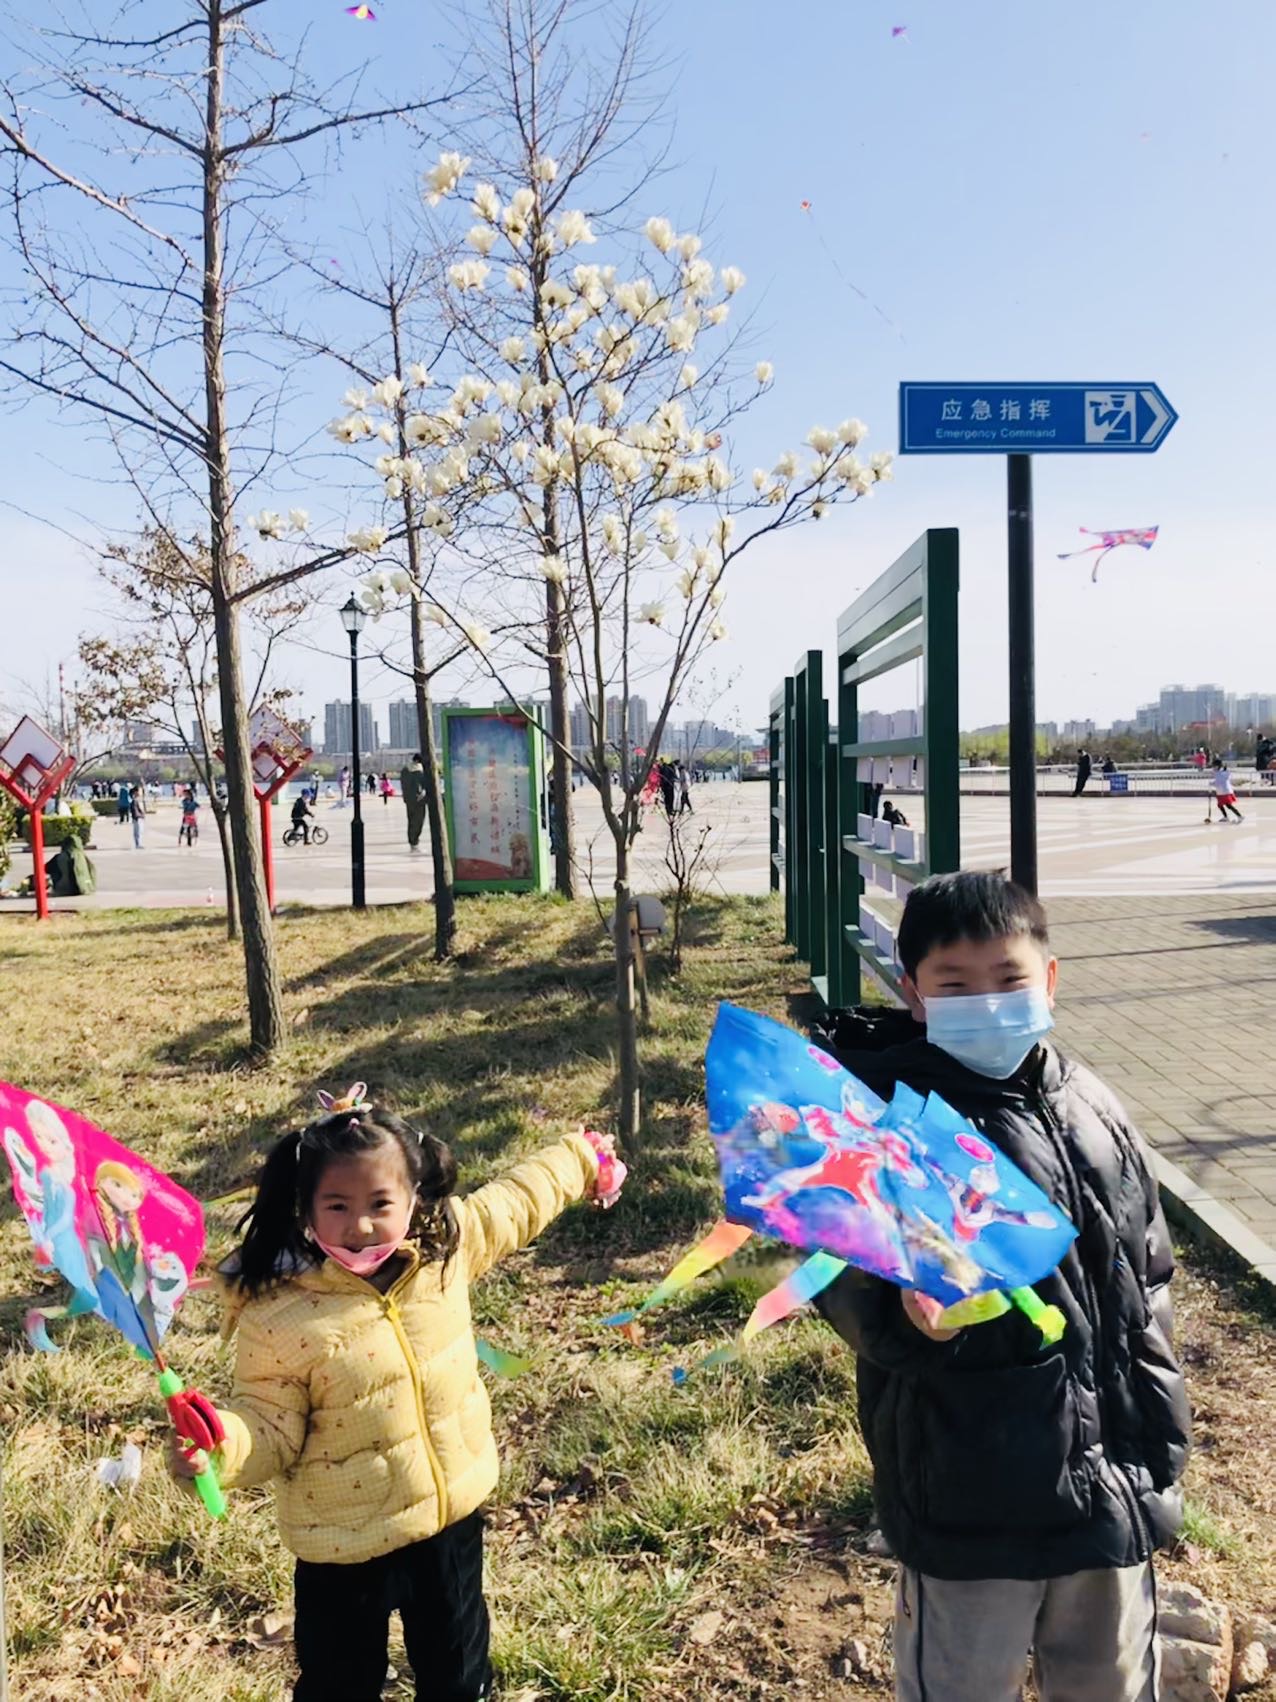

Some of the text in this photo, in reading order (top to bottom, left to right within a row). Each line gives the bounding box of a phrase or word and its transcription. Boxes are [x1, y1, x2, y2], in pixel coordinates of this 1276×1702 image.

[941, 398, 1052, 421] 应急指挥
[935, 428, 1056, 439] Emergency Command
